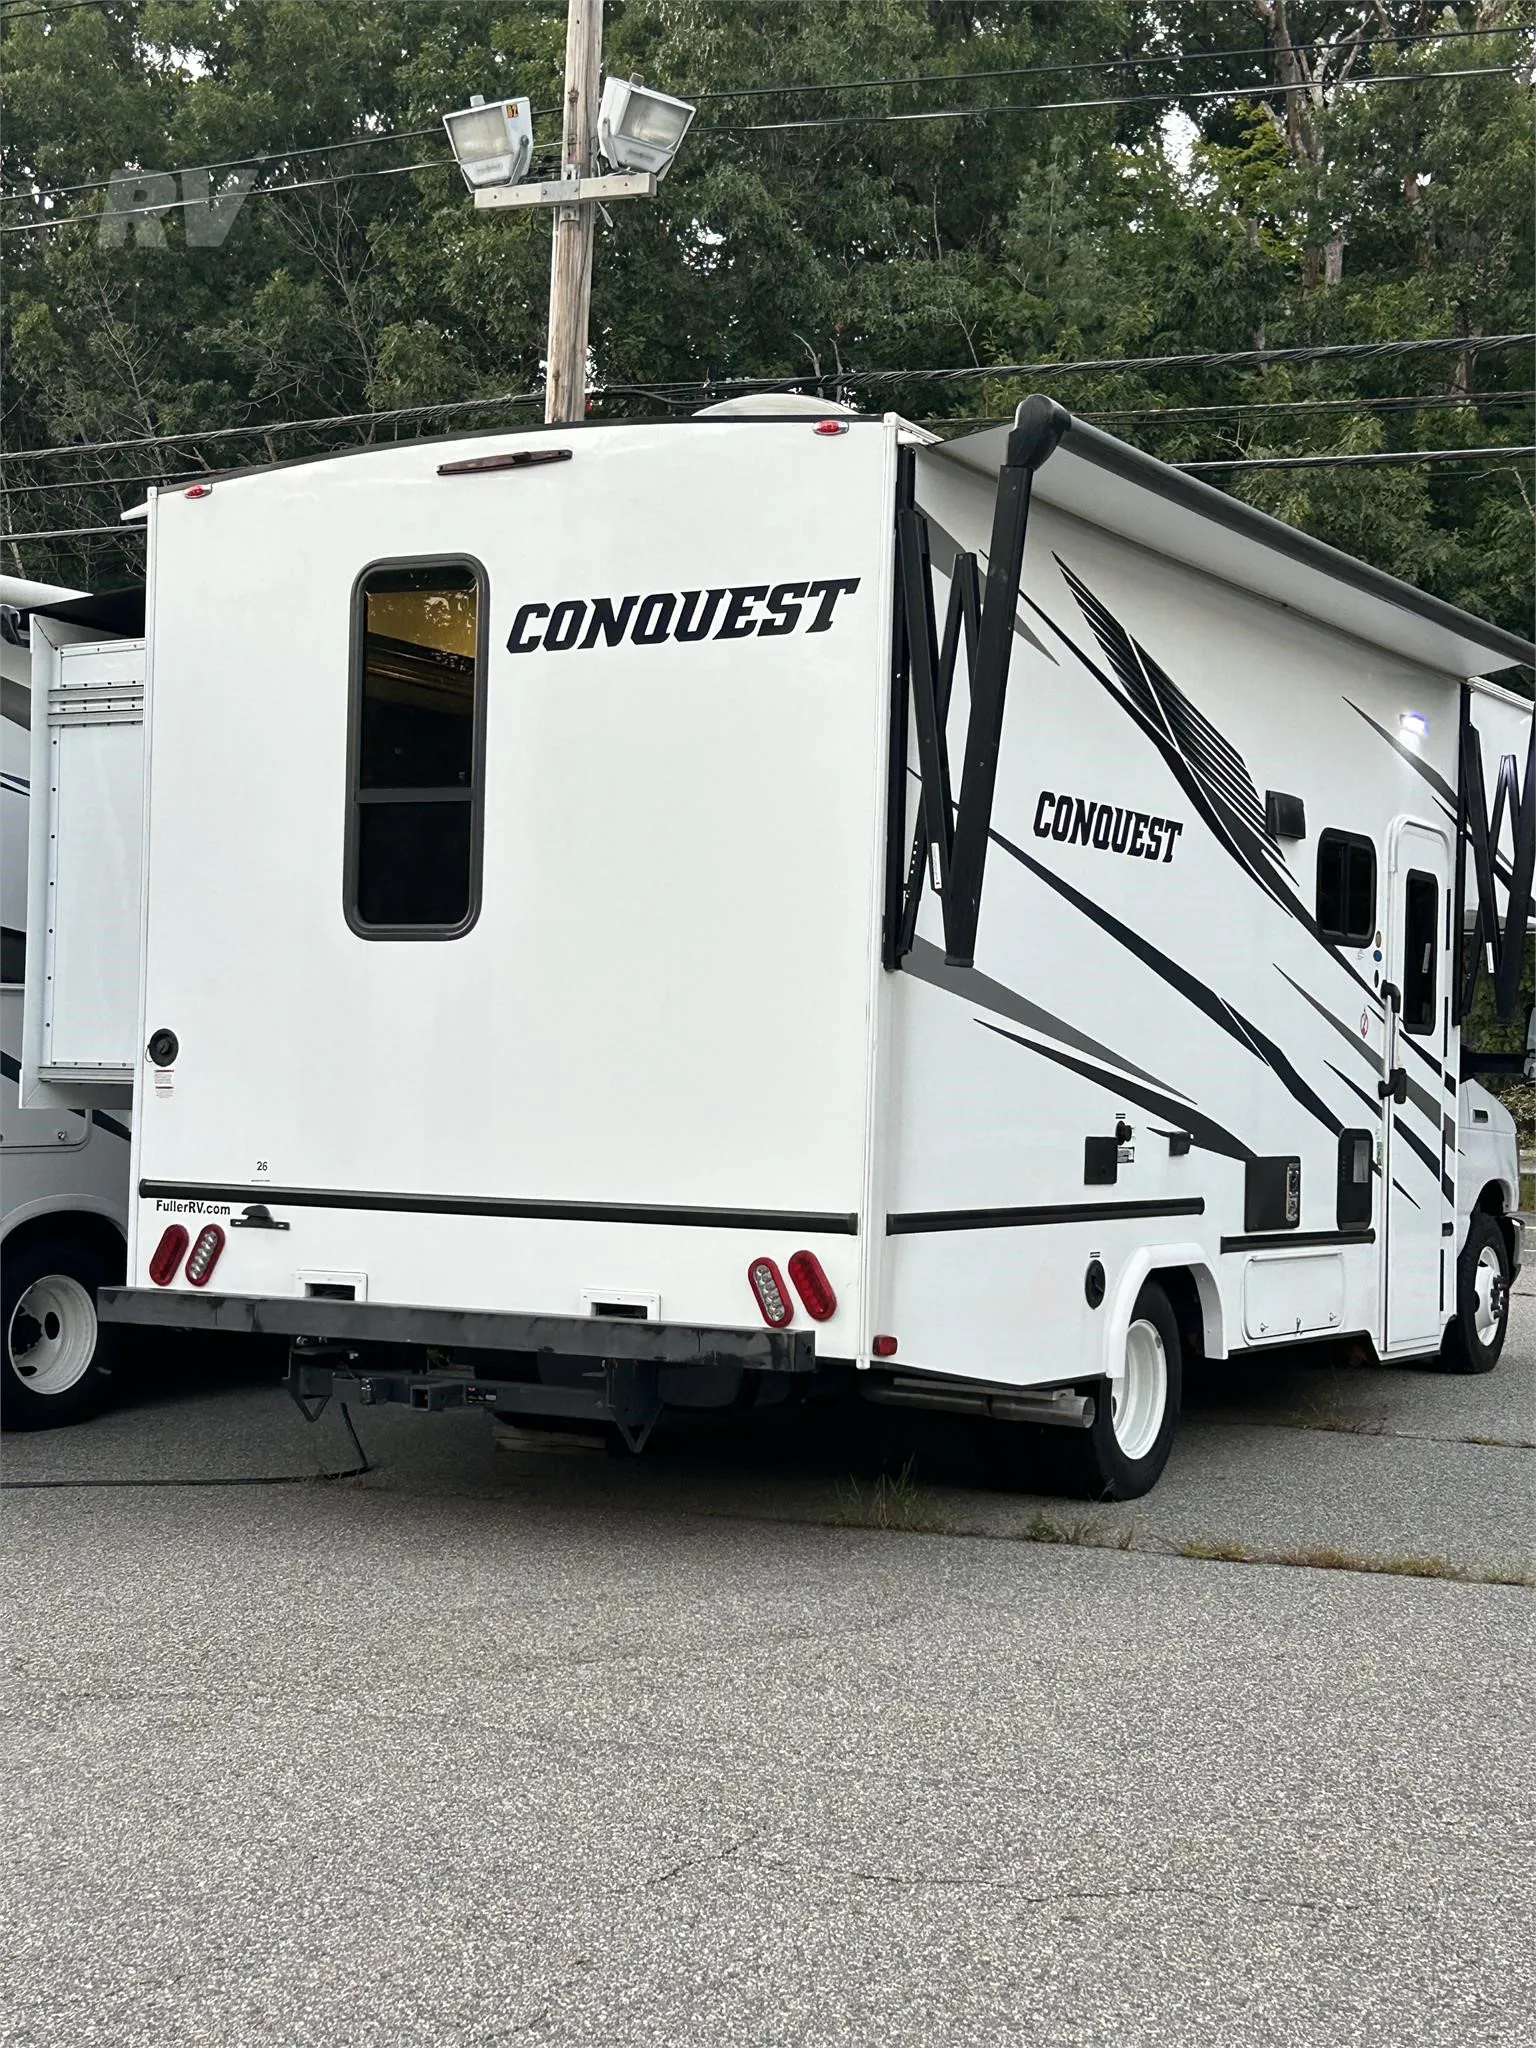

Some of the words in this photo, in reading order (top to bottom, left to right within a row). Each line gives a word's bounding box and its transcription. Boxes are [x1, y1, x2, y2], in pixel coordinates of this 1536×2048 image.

[506, 577, 861, 654] CONQUEST
[1033, 791, 1183, 863] CONQUEST
[256, 1161, 268, 1171] 26
[156, 1200, 231, 1215] FullerRV.com
